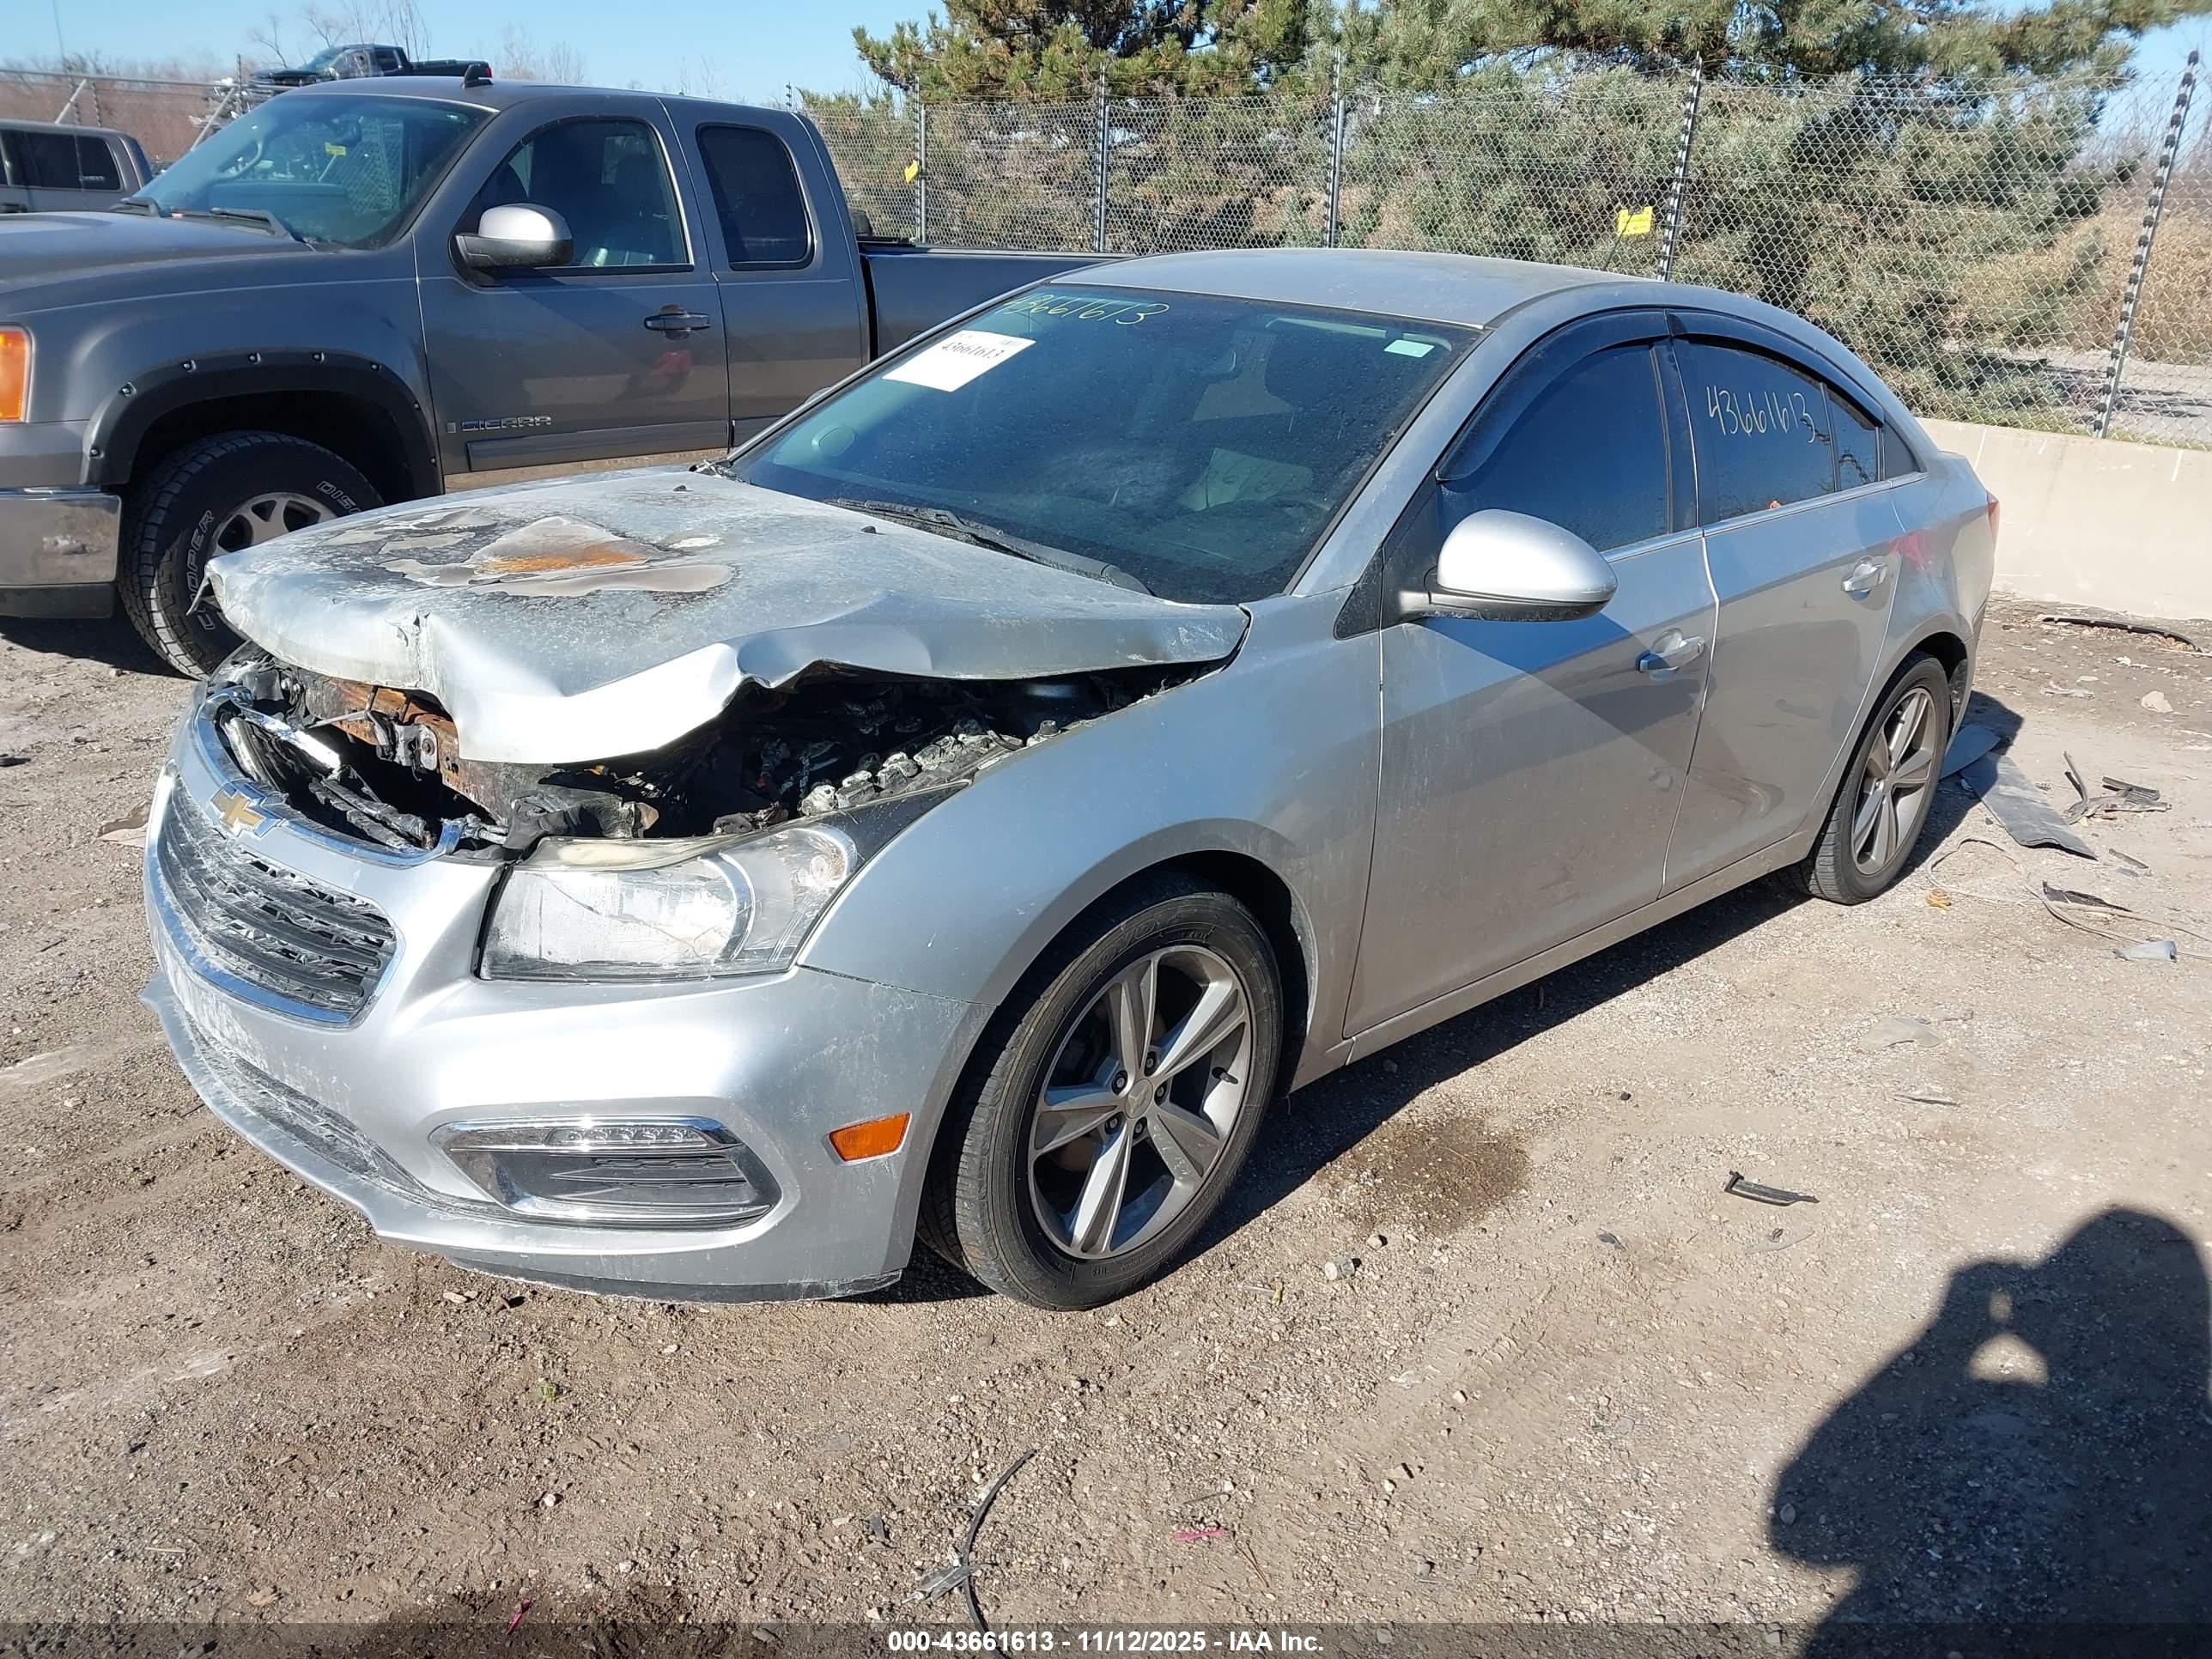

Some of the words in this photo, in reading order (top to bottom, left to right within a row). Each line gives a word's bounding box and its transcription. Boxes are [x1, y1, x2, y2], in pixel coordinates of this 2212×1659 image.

[994, 292, 1170, 325] 43661613
[460, 415, 552, 433] SIERRA
[1705, 385, 1816, 443] 43661613
